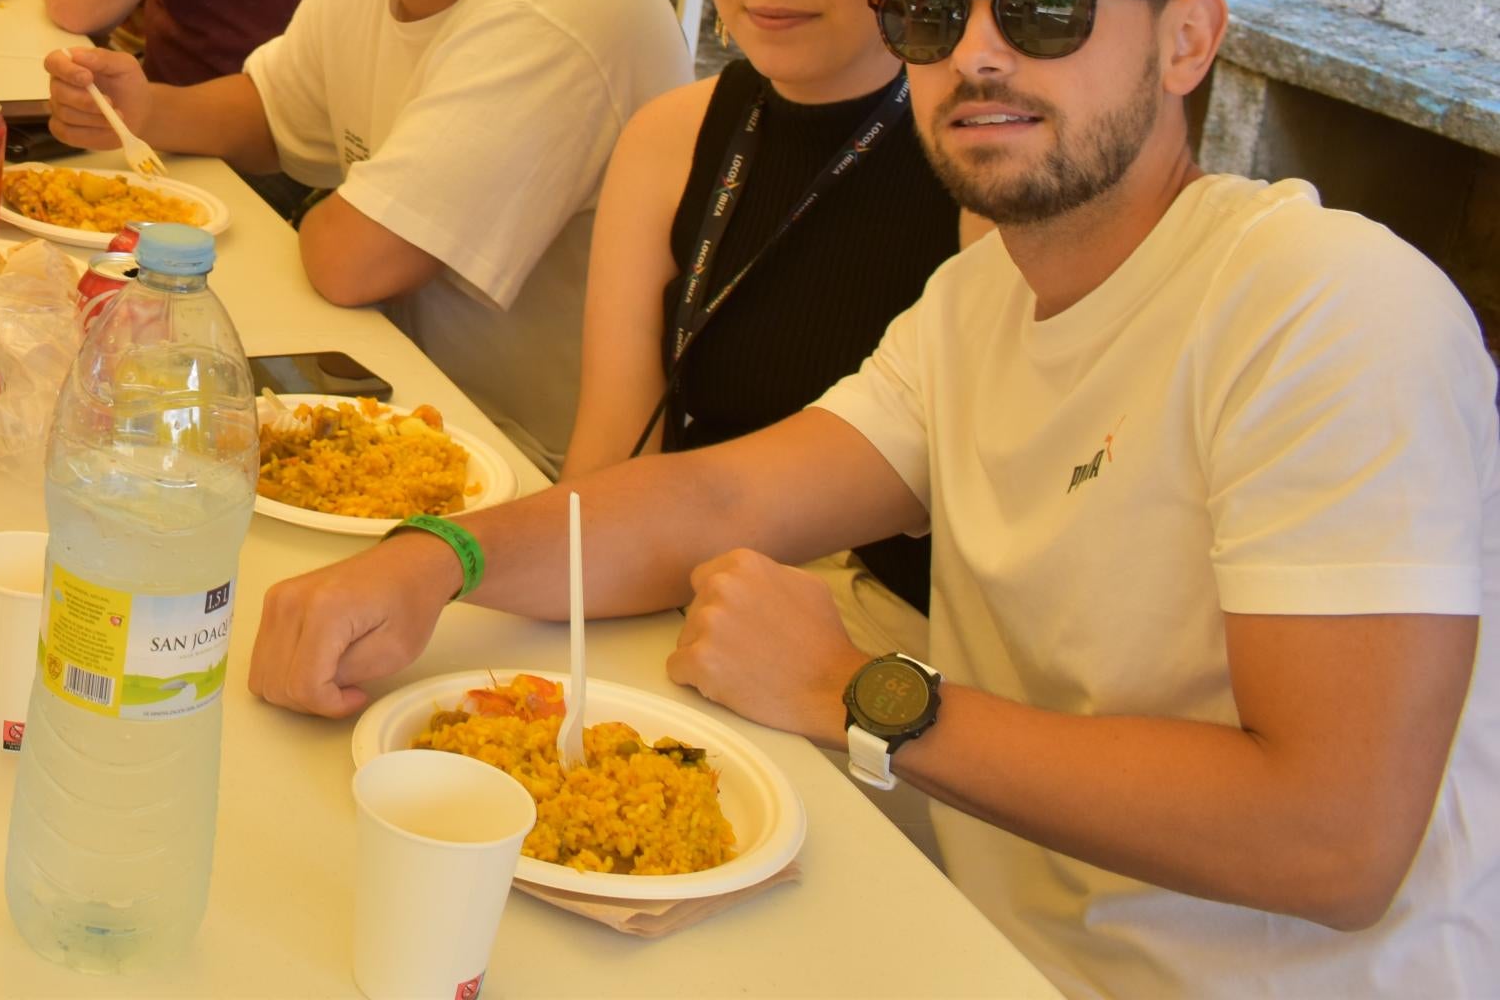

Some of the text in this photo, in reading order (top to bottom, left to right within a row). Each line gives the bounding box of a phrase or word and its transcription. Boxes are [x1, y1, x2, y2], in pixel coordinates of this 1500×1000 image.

[862, 122, 885, 148] LOCOS
[726, 154, 744, 184] LOCOS
[832, 153, 855, 176] IBIZA
[712, 192, 730, 218] IBIZA
[696, 239, 712, 269] LOCOS
[149, 635, 188, 653] SAN
